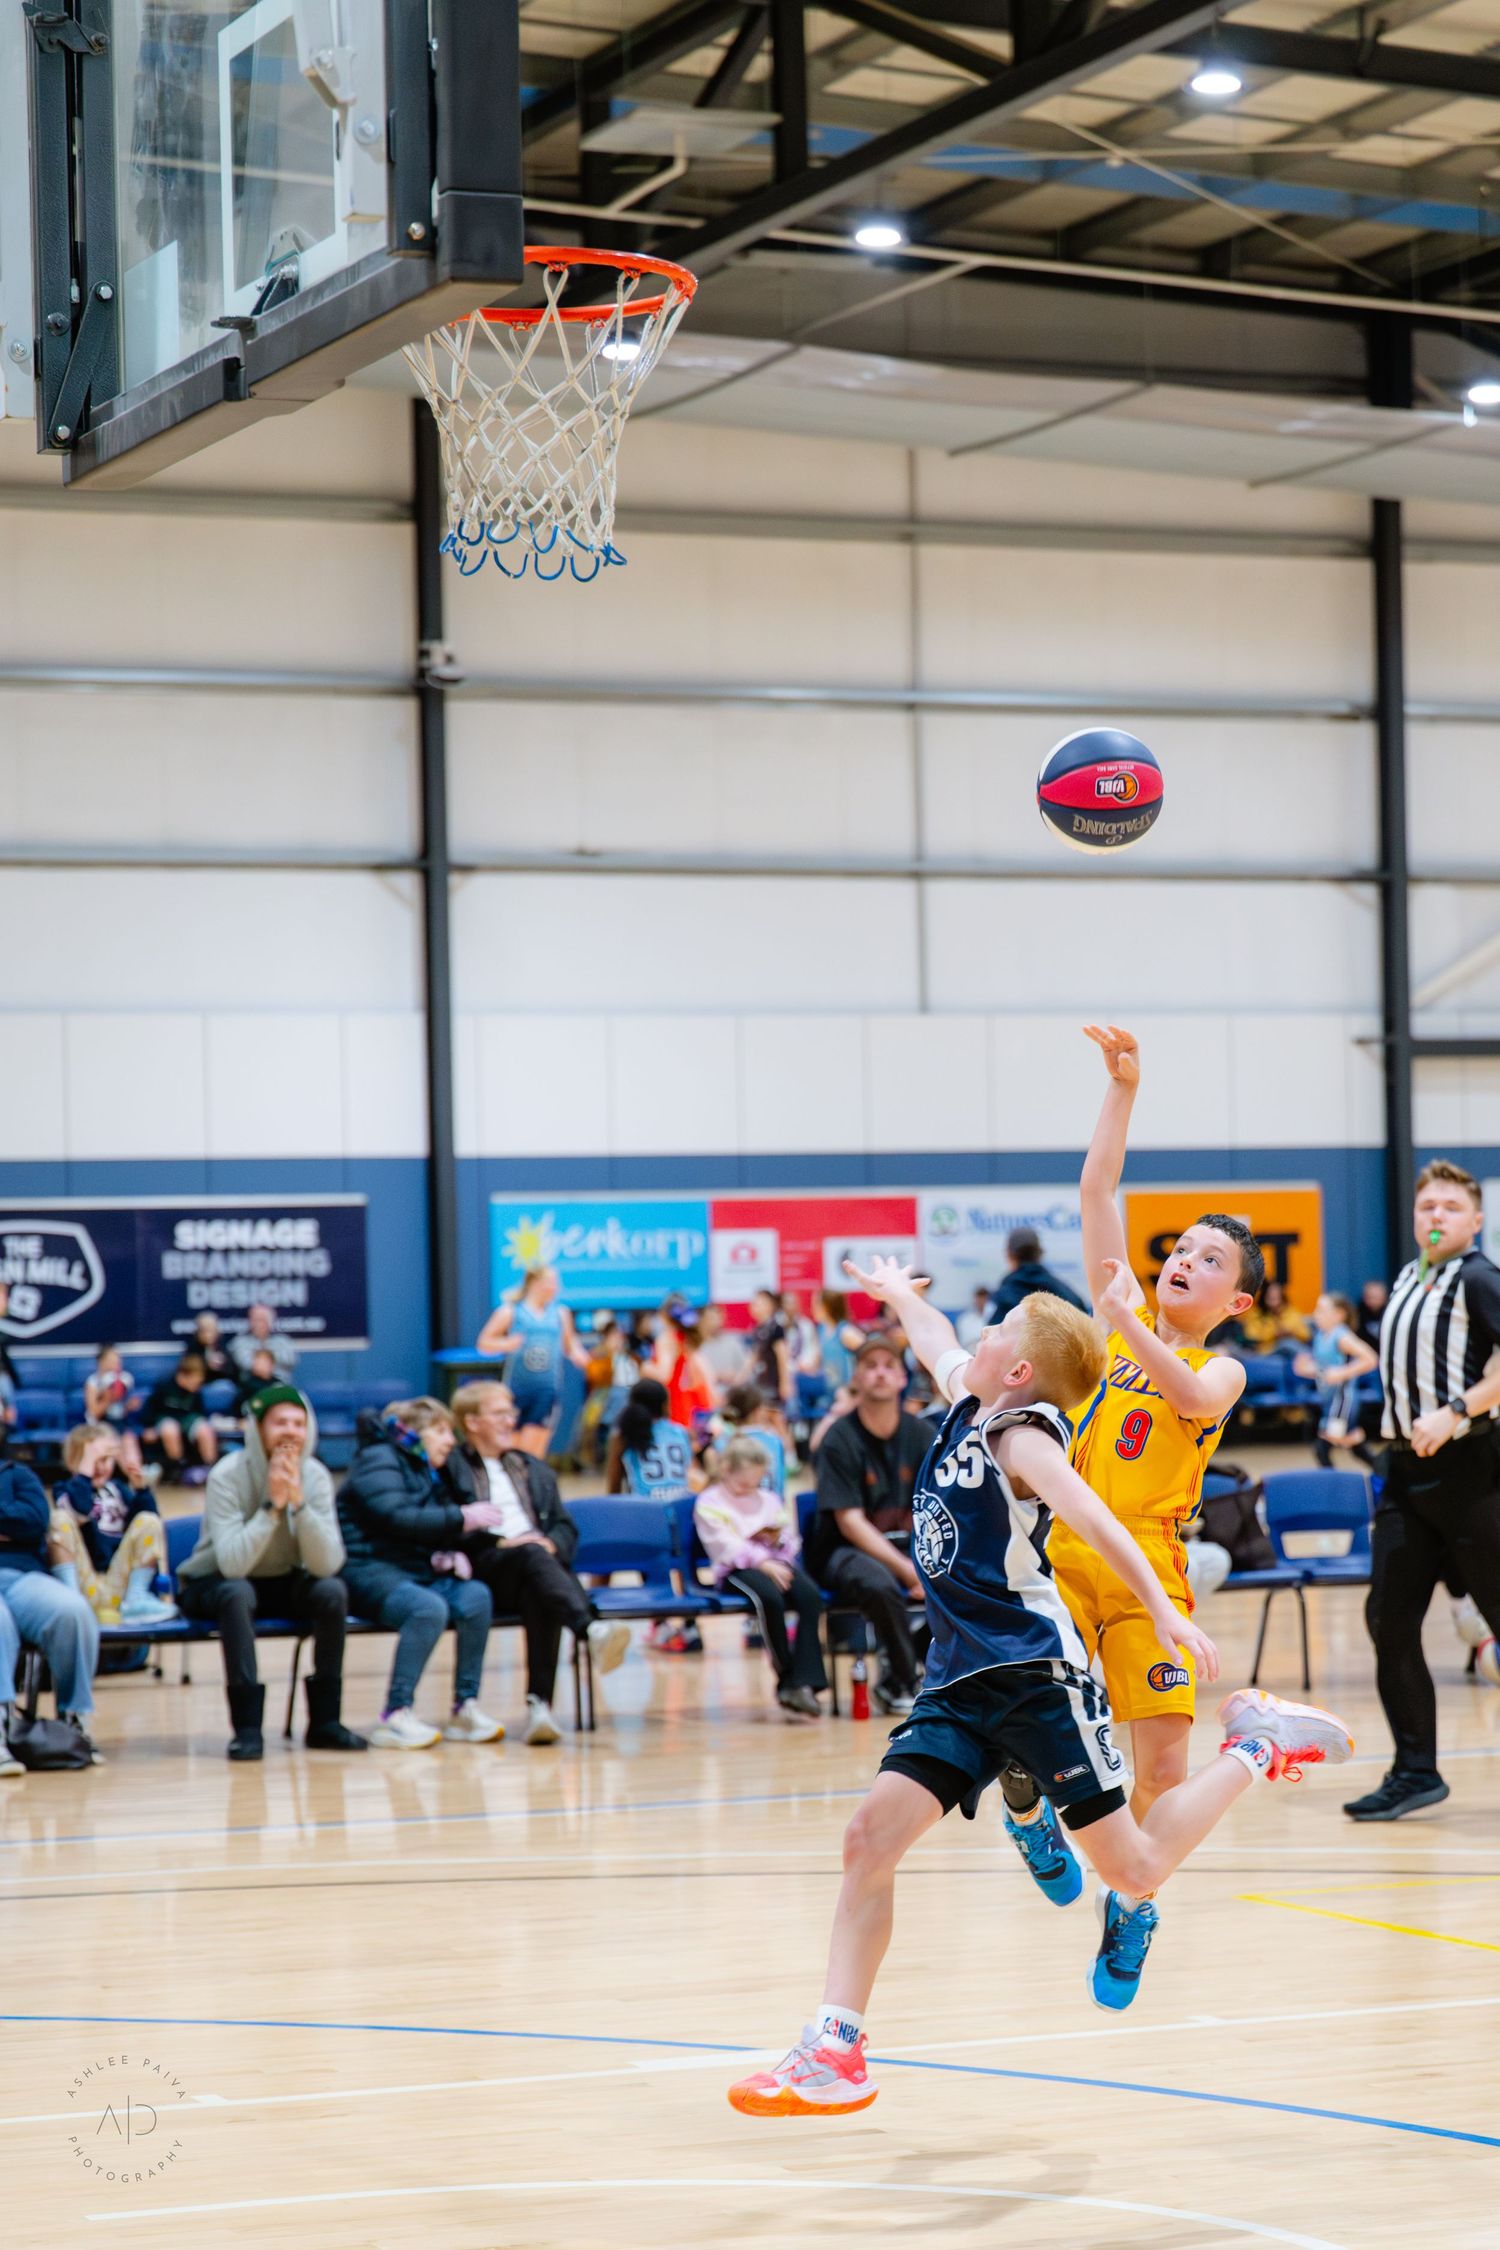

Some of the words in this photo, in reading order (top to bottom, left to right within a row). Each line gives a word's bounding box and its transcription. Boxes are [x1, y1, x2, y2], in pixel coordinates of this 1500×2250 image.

[1099, 779, 1125, 794] VJBL
[1073, 810, 1153, 836] SPALDING
[3, 1235, 43, 1259] THE
[174, 1218, 320, 1250] SIGNAGE
[26, 1256, 88, 1291] MILL
[161, 1248, 332, 1280] BRANDING
[186, 1278, 309, 1309] DESIGN
[1115, 1408, 1152, 1460] 9
[641, 1443, 687, 1481] 59
[927, 1500, 954, 1540] UNITED
[1164, 1669, 1189, 1685] VJBL
[838, 2020, 860, 2046] NBA
